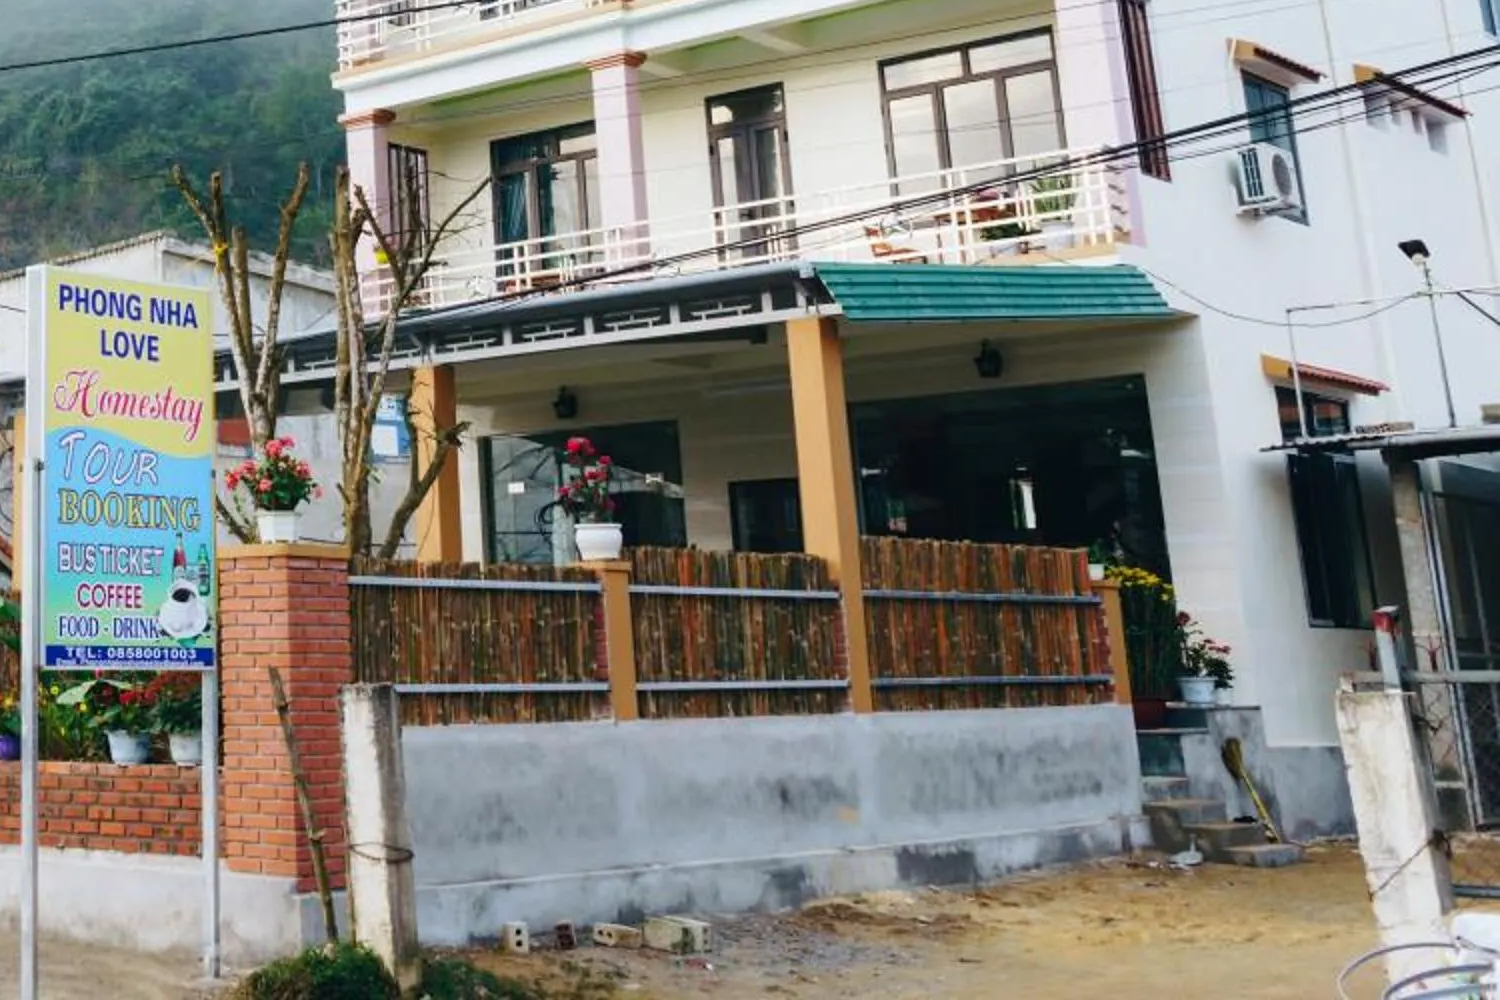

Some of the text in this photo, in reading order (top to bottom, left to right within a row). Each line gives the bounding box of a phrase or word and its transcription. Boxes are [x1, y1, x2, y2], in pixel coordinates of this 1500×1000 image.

[59, 284, 198, 329] PHONG NHA
[100, 329, 160, 361] LOVE
[53, 369, 204, 443] Homestay
[59, 430, 159, 486] TOUR
[58, 488, 201, 532] BOOKING
[58, 542, 164, 576] BUS TICKET
[76, 583, 144, 609] COFFEE
[59, 615, 99, 638] FOOD
[66, 647, 102, 660] TEL:
